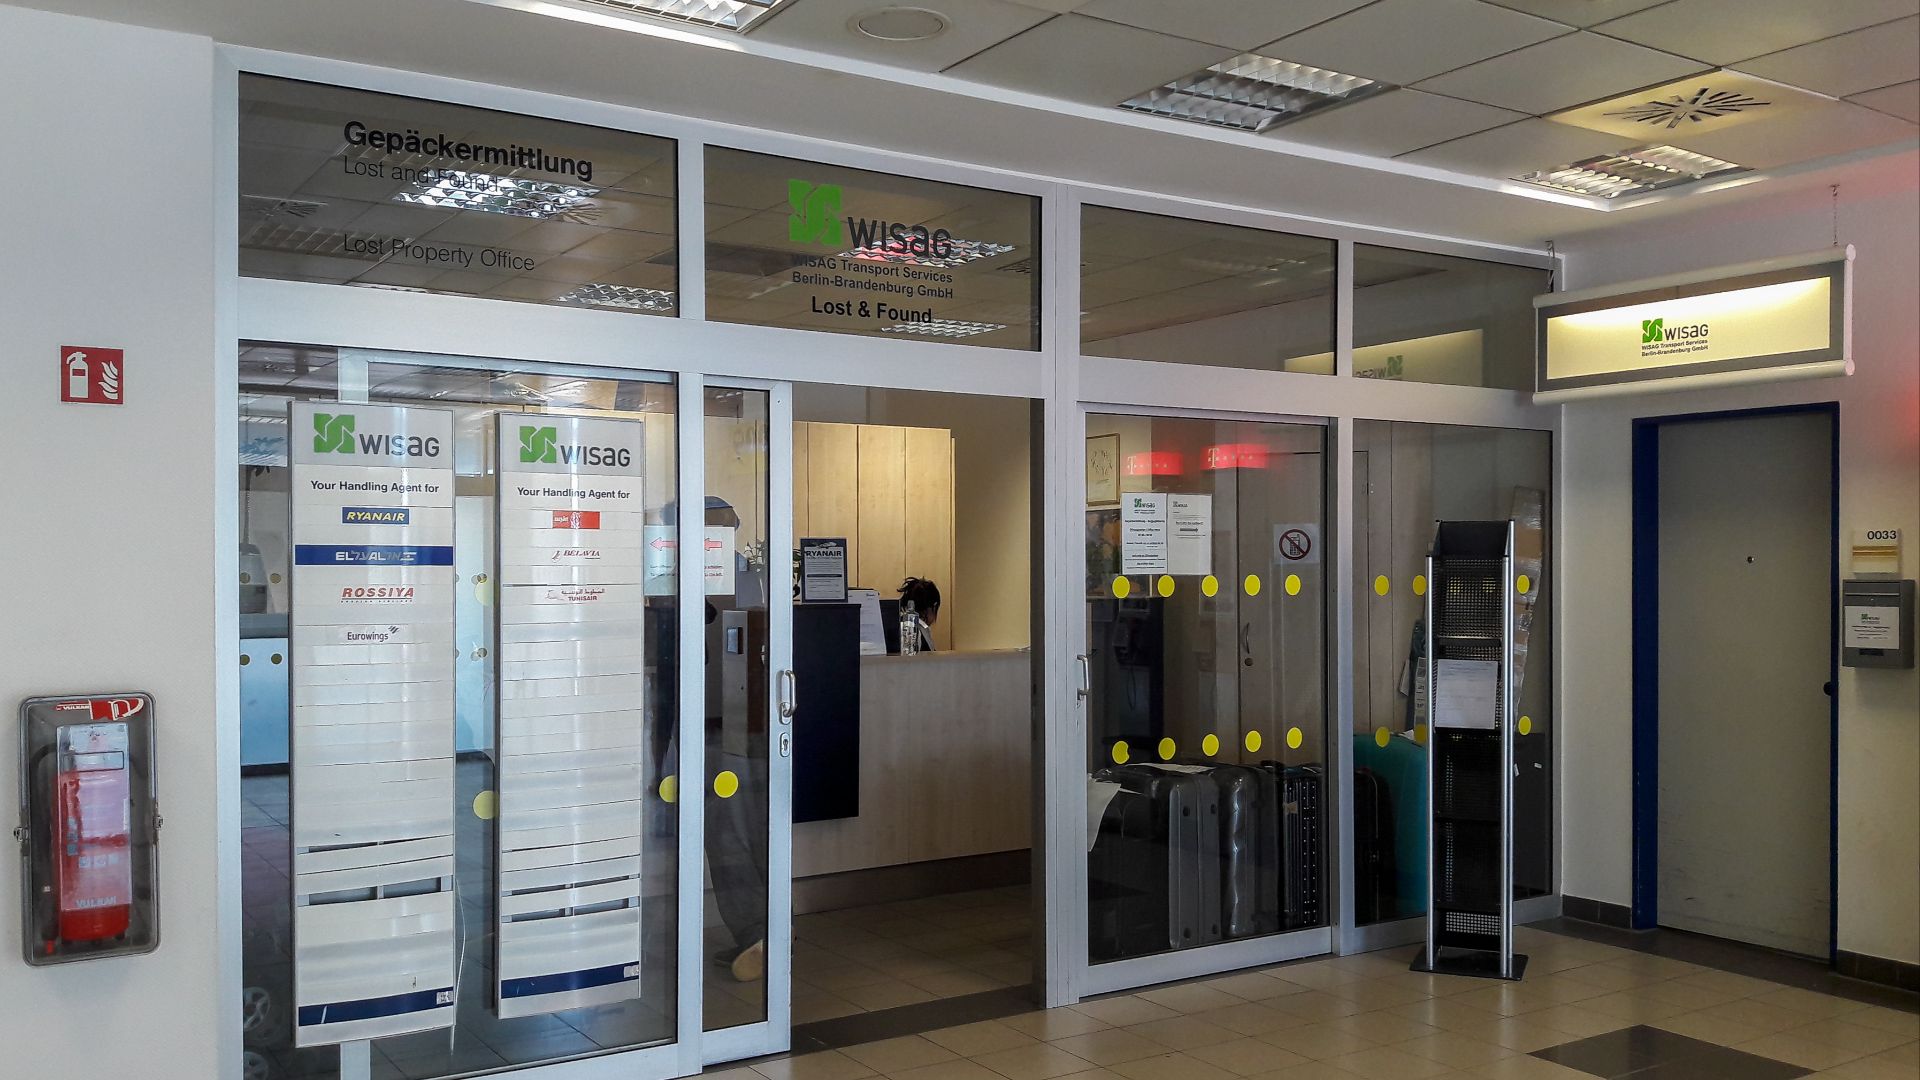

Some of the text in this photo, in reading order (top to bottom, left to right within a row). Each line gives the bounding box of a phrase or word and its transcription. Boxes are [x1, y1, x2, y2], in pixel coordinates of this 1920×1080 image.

[344, 121, 593, 182] Gepäckermittlung
[344, 155, 501, 192] Lost and Found
[344, 234, 535, 272] Lost Property Office
[841, 259, 899, 277] Transport
[902, 264, 953, 283] Services
[792, 271, 953, 299] Berlin-Brandenburg GmbH
[811, 295, 932, 324] Lost & Found
[1660, 340, 1685, 349] Transport
[1641, 347, 1691, 357] Berlin-Brandenburg
[311, 480, 439, 494] Your Handling Agent for
[517, 487, 631, 500] Your Handling Agent for
[346, 511, 405, 522] RYANAIR
[1867, 530, 1897, 540] 0033
[563, 549, 601, 557] BELAVIA
[342, 587, 414, 598] ROSSIYA
[347, 631, 389, 642] Eurowings
